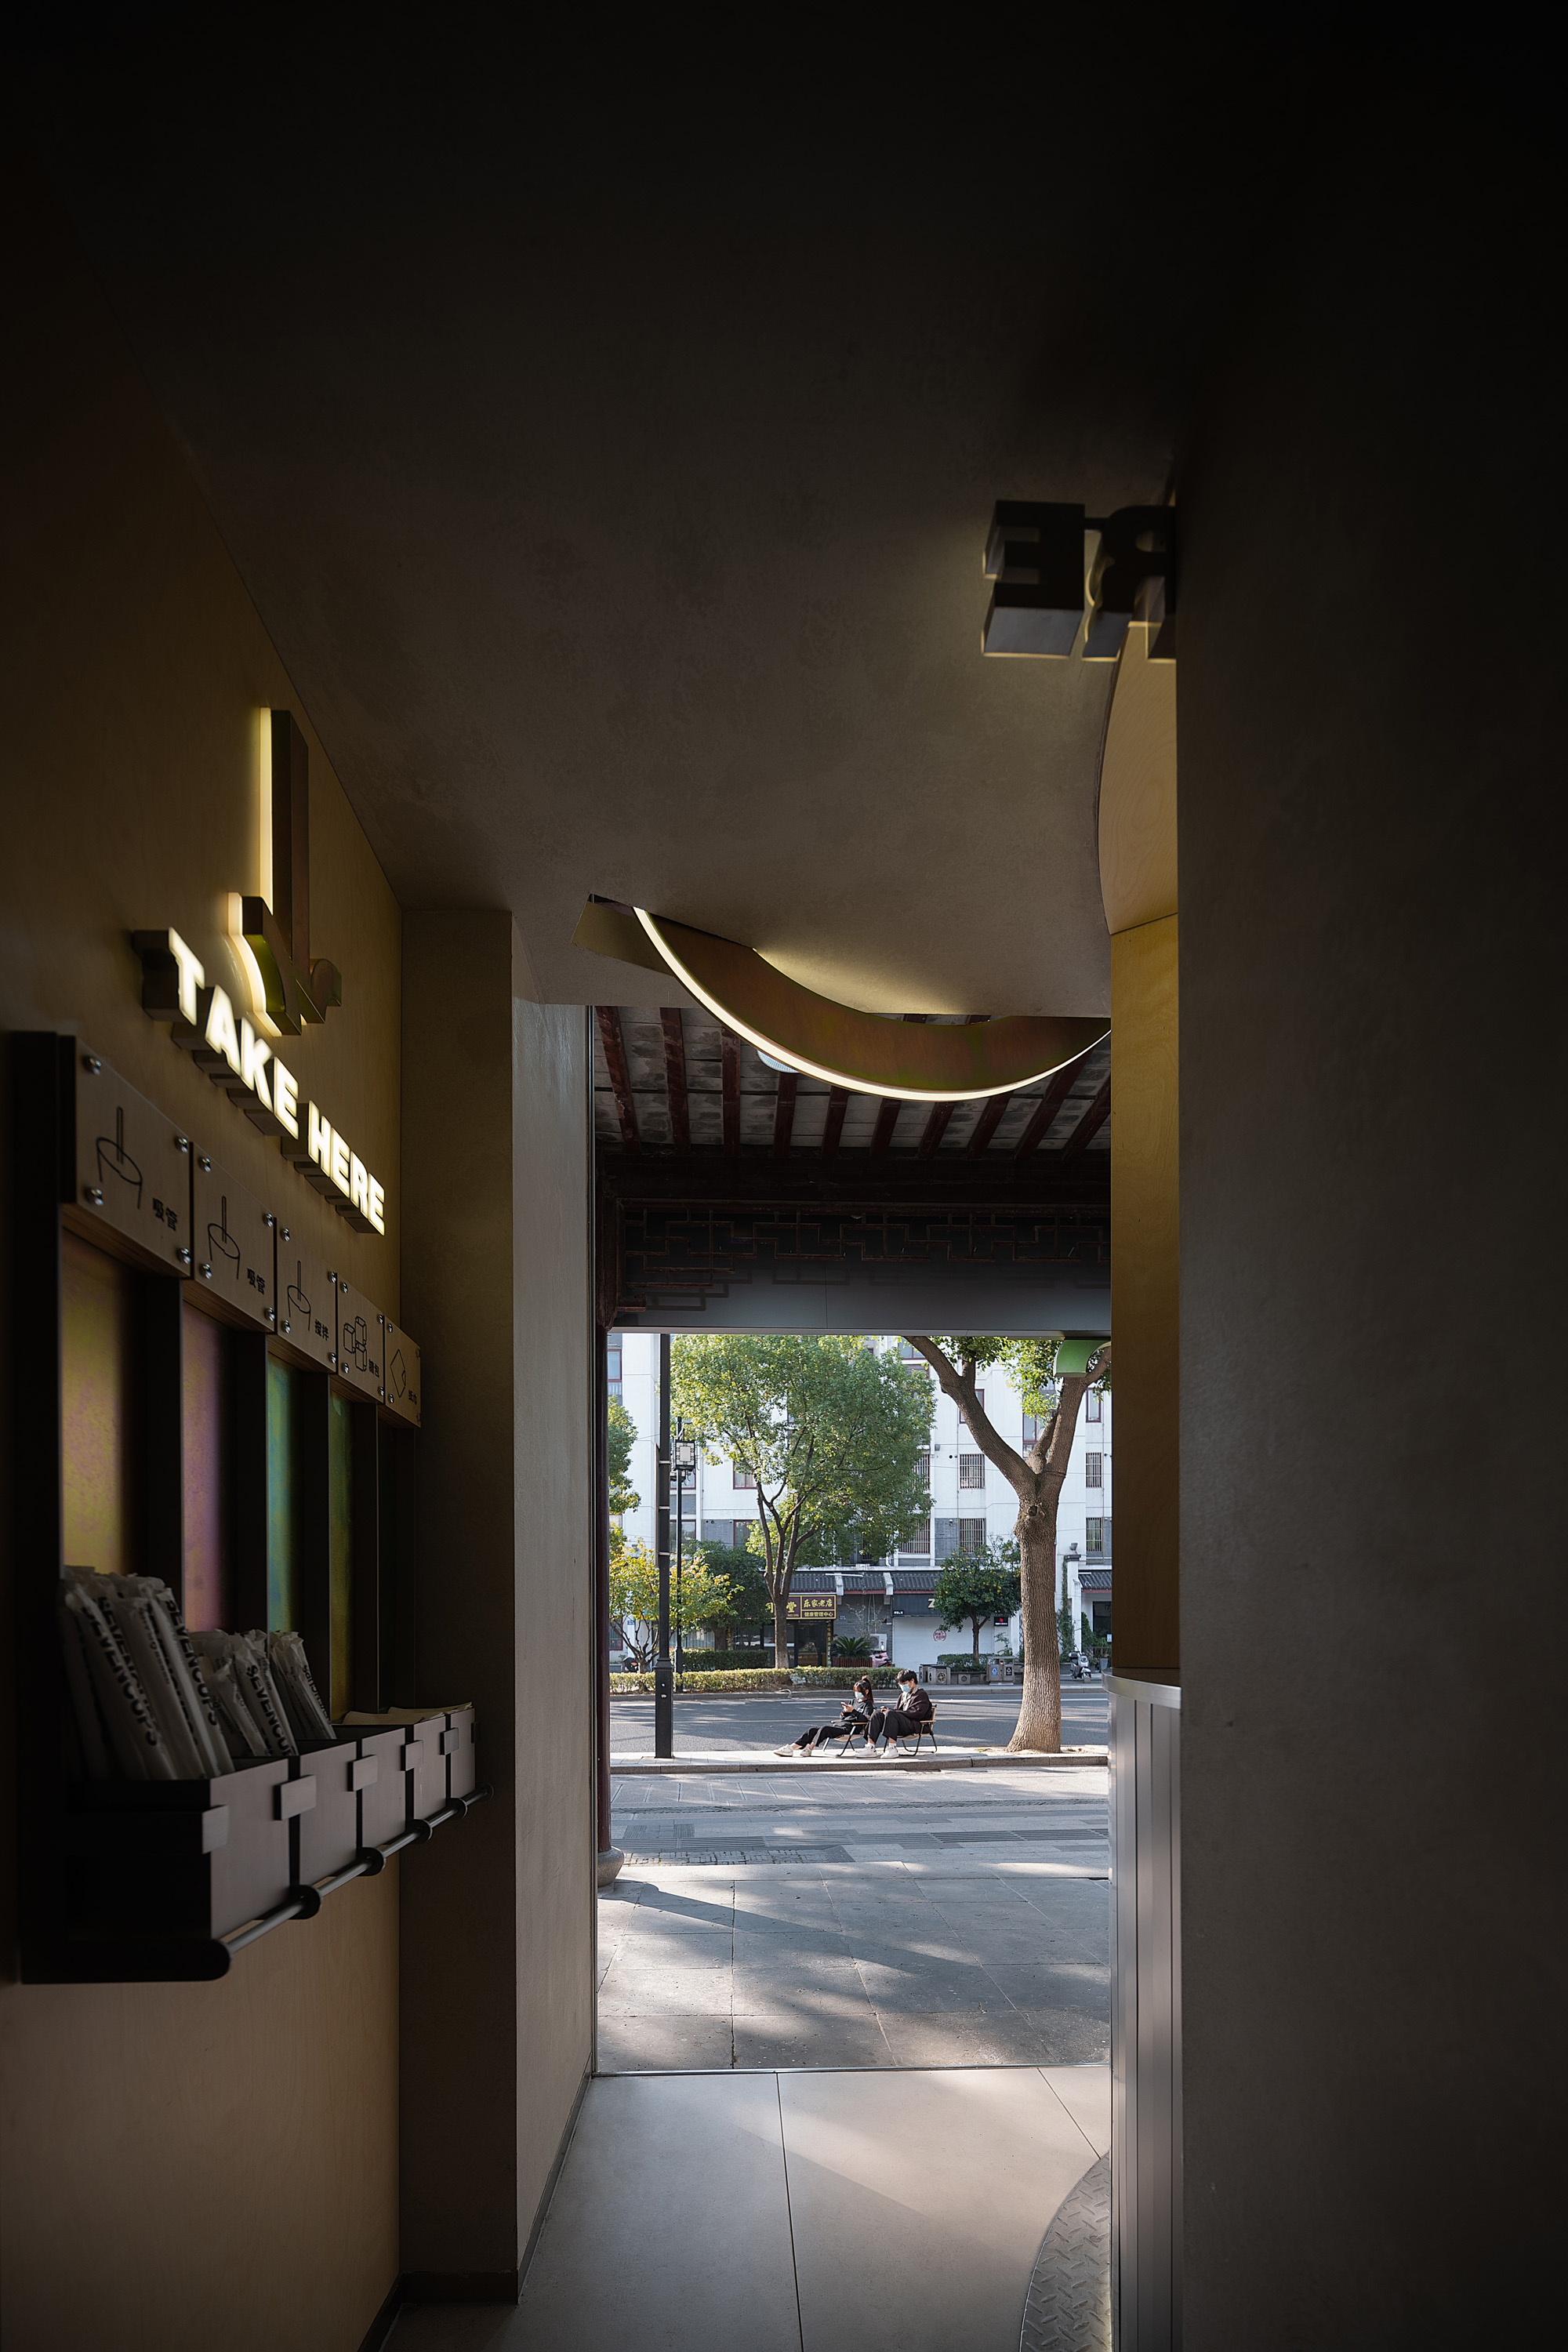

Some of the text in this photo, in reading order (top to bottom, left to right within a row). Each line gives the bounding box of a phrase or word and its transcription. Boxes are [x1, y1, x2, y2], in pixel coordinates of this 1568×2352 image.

[168, 926, 385, 1236] TAKE HERE
[152, 1197, 178, 1232] 吸管
[246, 1267, 266, 1295] 吸管
[804, 1599, 833, 1607] 乐家老店
